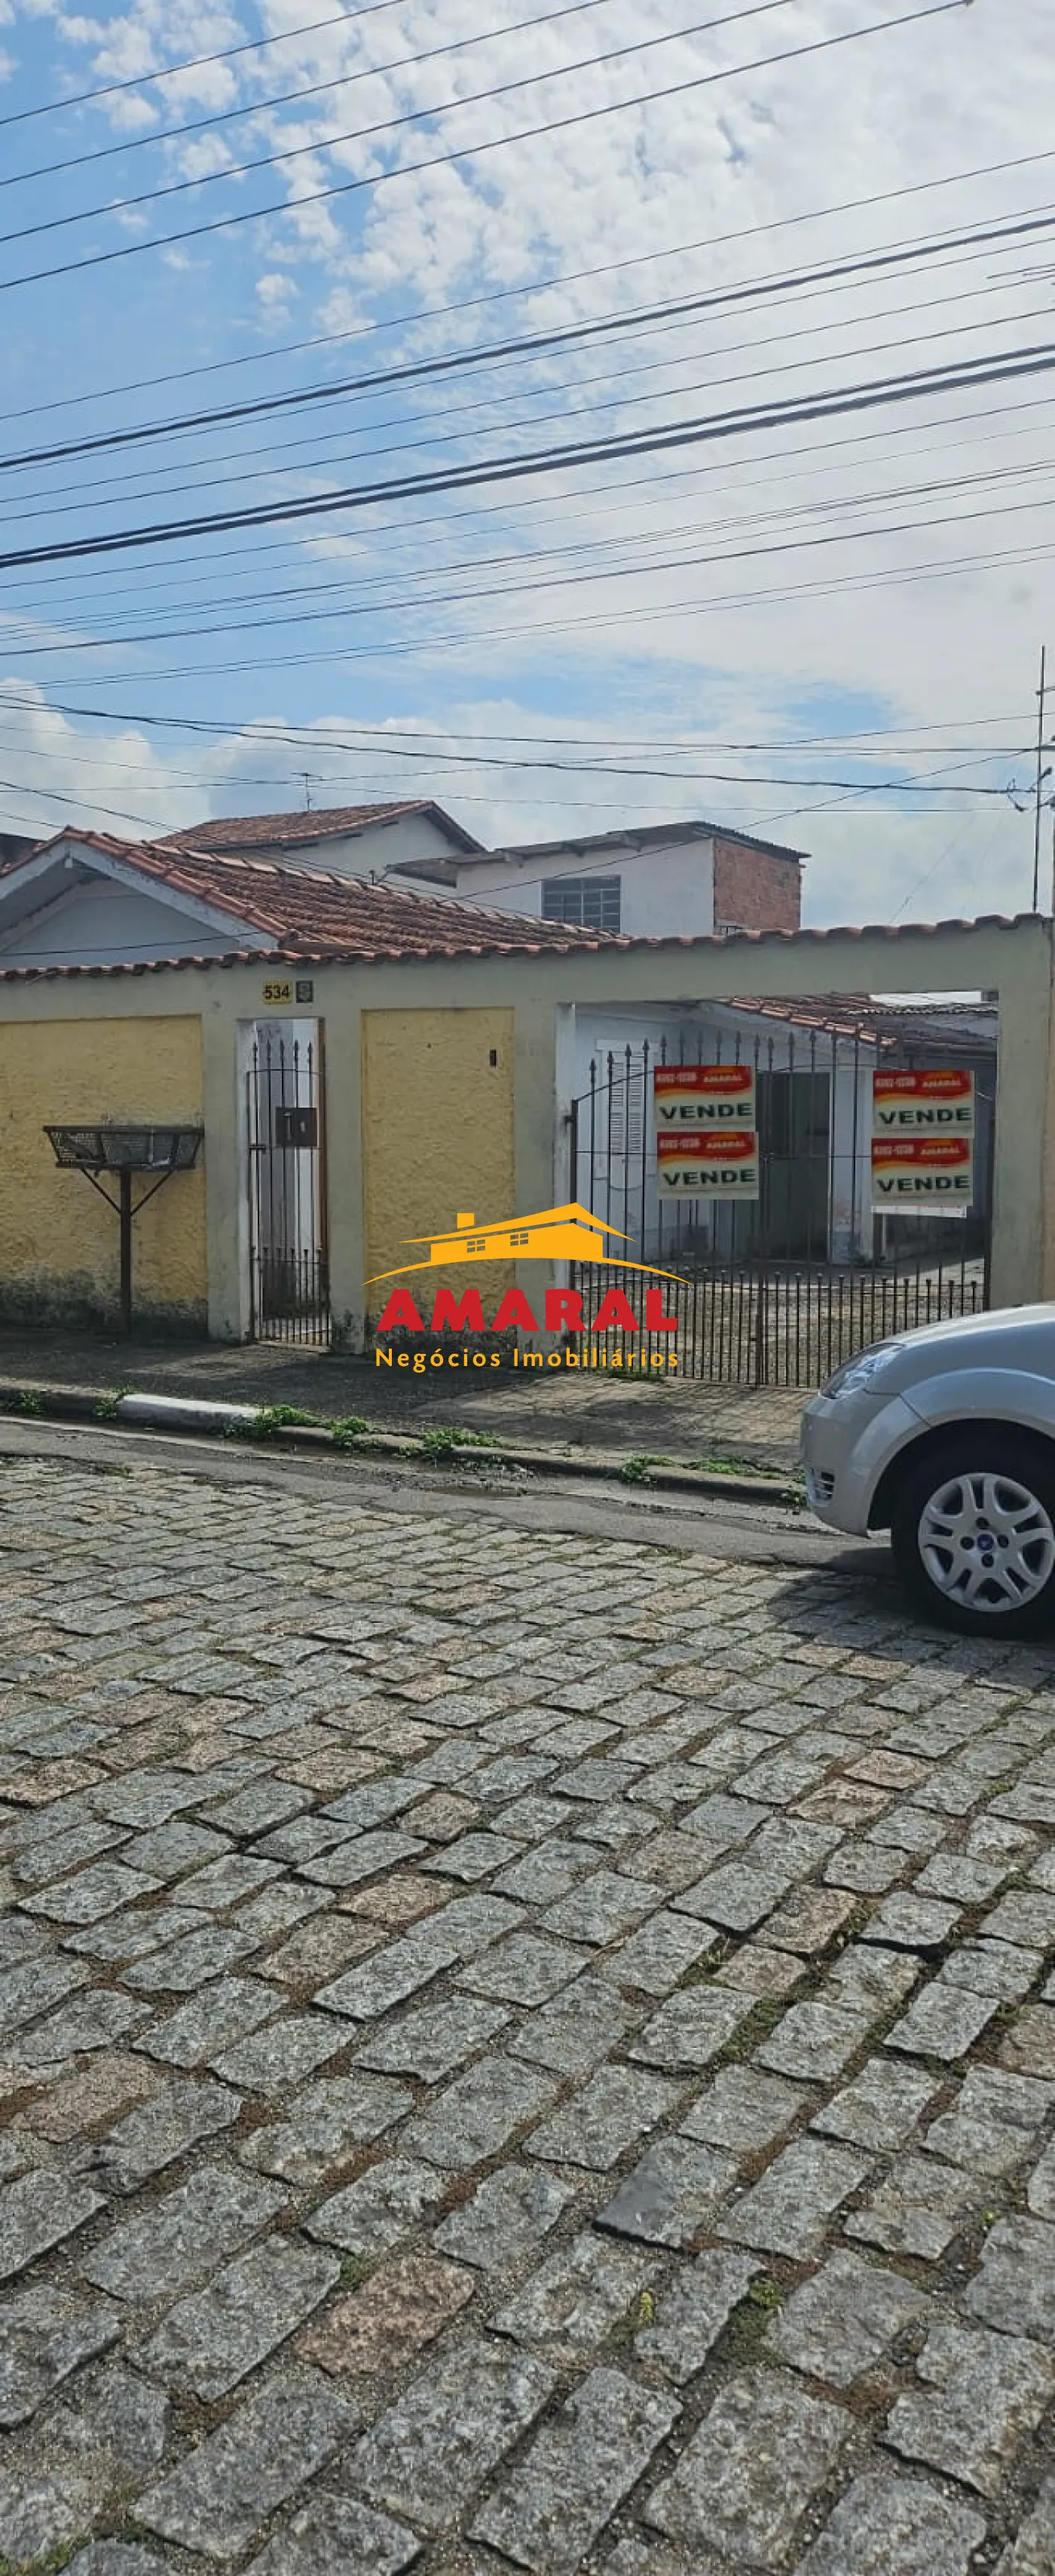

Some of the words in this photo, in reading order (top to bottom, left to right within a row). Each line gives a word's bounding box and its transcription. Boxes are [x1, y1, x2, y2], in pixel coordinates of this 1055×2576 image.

[262, 985, 289, 1000] 534
[660, 1103, 752, 1119] VENDE
[879, 1108, 971, 1124] VENDE
[663, 1169, 755, 1185] VENDE
[876, 1175, 970, 1192] VENDE
